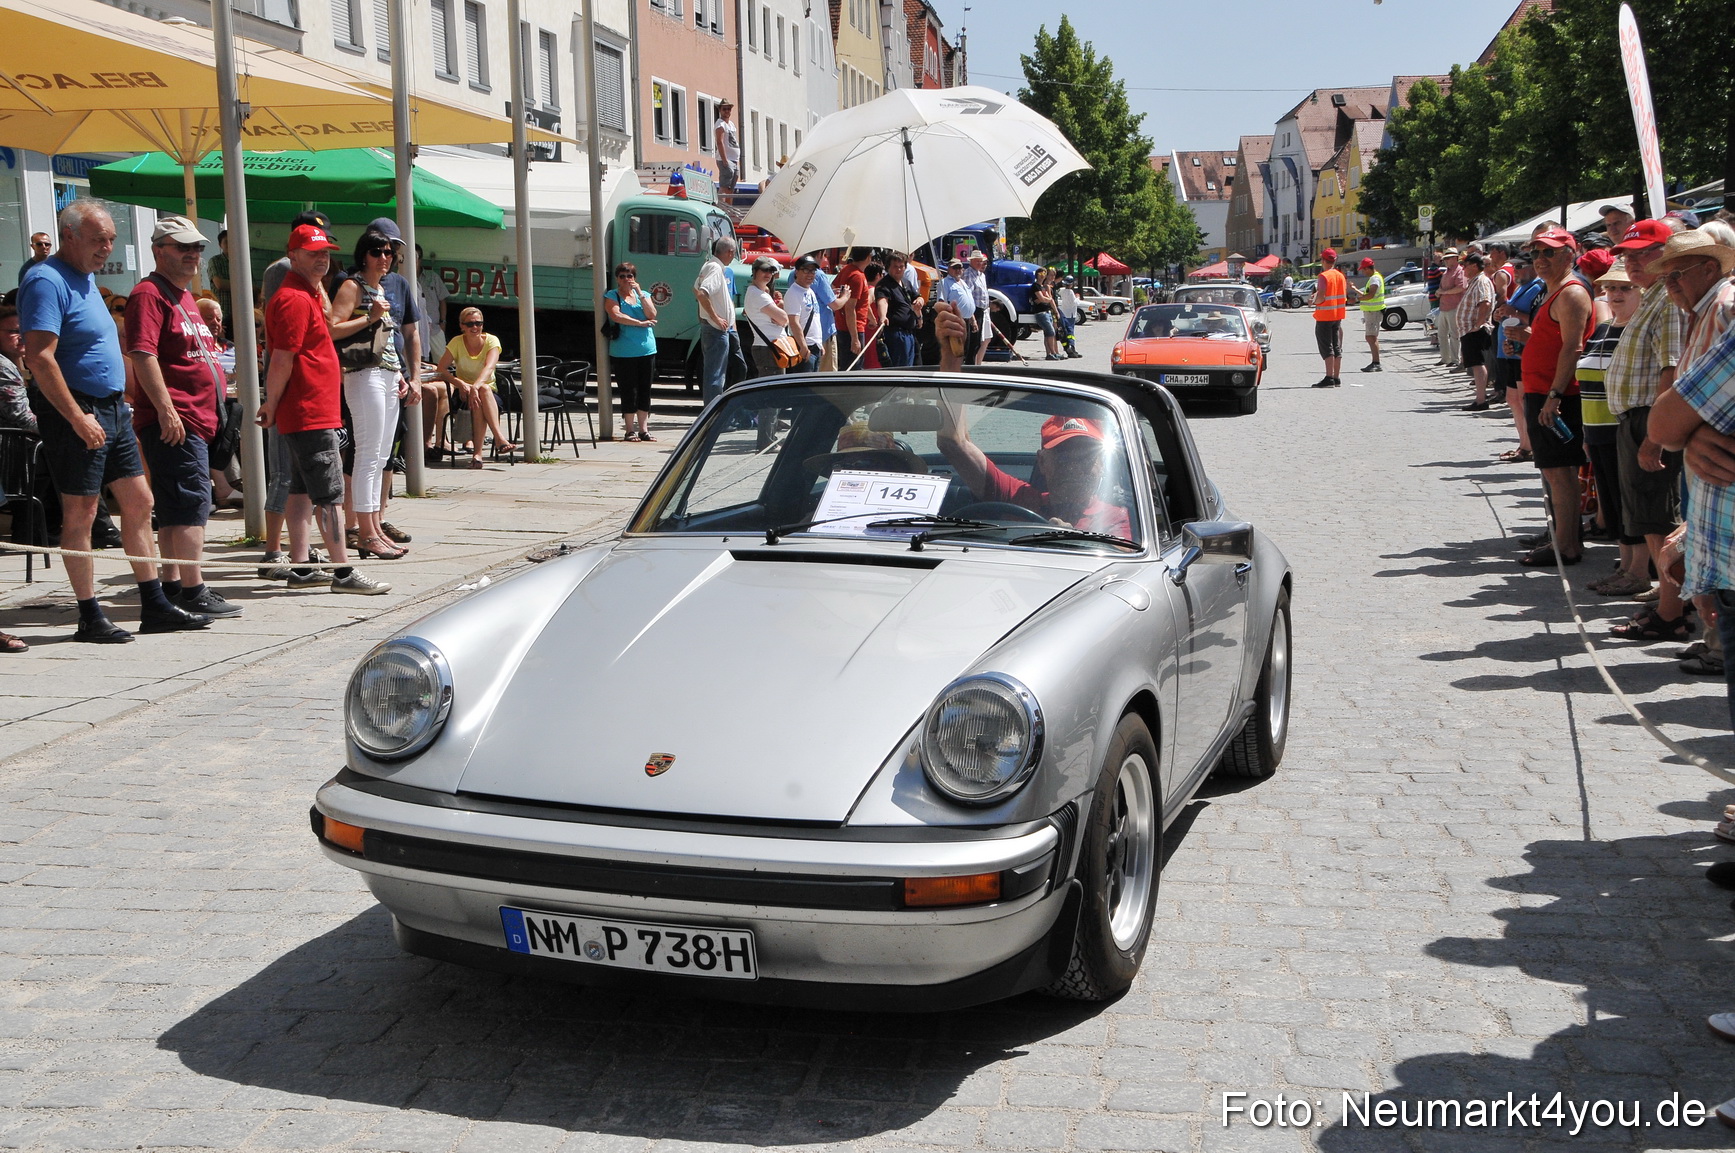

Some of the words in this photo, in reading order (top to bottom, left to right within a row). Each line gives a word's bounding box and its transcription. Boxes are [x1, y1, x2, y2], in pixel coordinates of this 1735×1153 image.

[213, 155, 308, 164] Nmarkter
[440, 264, 519, 300] BRÄ
[1165, 375, 1179, 384] CHA
[1184, 375, 1189, 384] P
[1190, 375, 1209, 384] 914H
[879, 486, 918, 501] 145
[512, 933, 523, 944] D
[525, 916, 581, 956] NM
[601, 925, 628, 961] P
[637, 929, 752, 973] 738H
